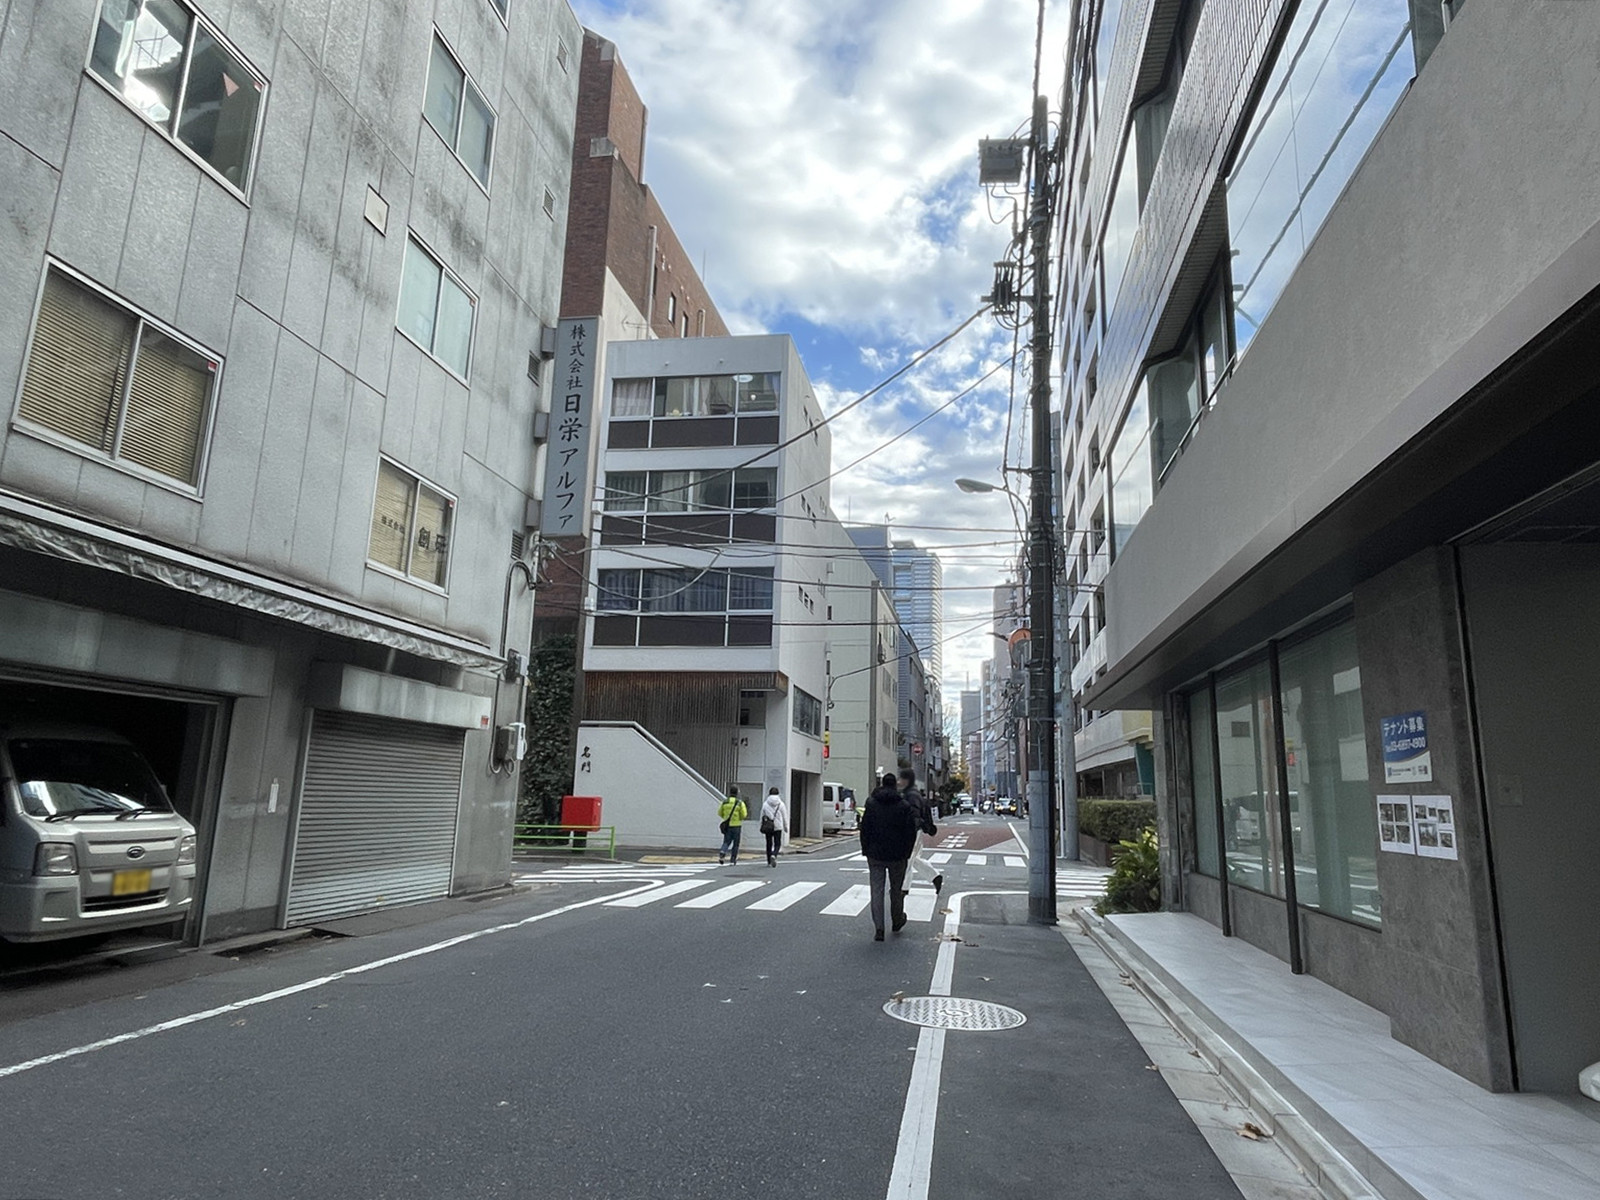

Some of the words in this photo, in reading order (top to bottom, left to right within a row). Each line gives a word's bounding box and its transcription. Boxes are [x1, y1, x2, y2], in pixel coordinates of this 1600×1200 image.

[556, 324, 587, 530] 株式会社日栄アルファ
[1384, 717, 1424, 736] テナント募集
